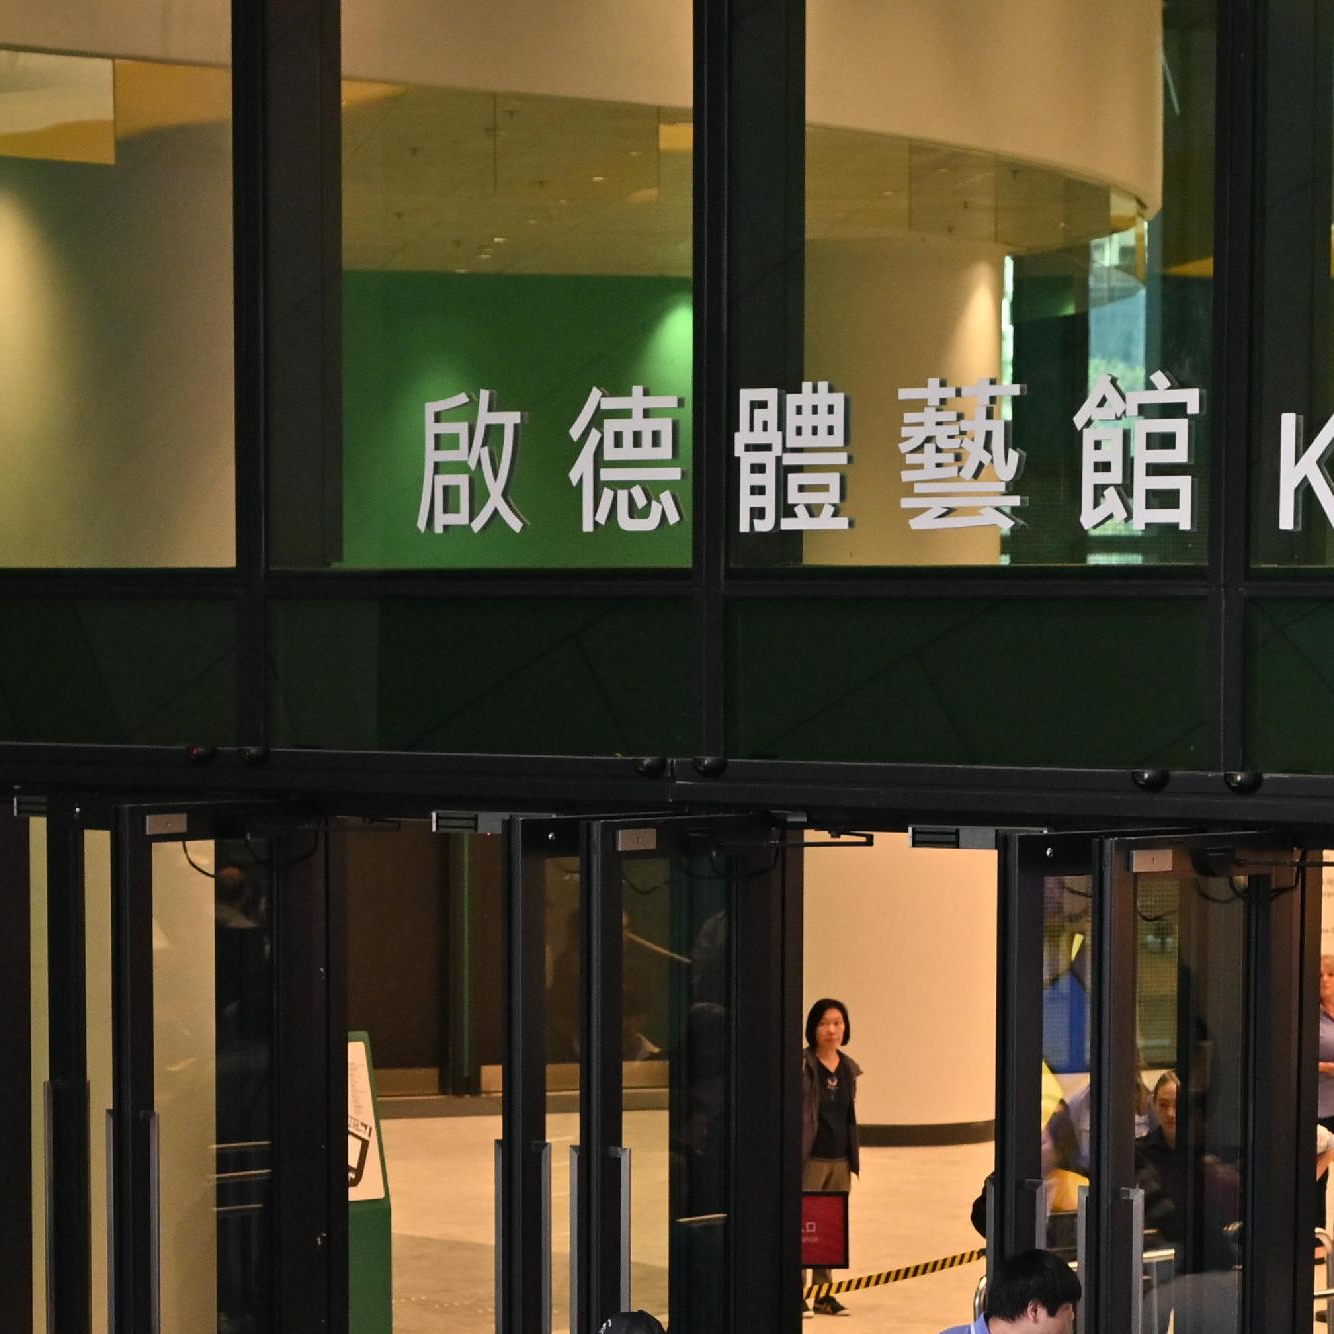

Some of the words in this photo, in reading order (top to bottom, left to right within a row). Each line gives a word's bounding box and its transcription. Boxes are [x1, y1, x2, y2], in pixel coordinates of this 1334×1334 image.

[416, 370, 1202, 533] 啟德體藝館
